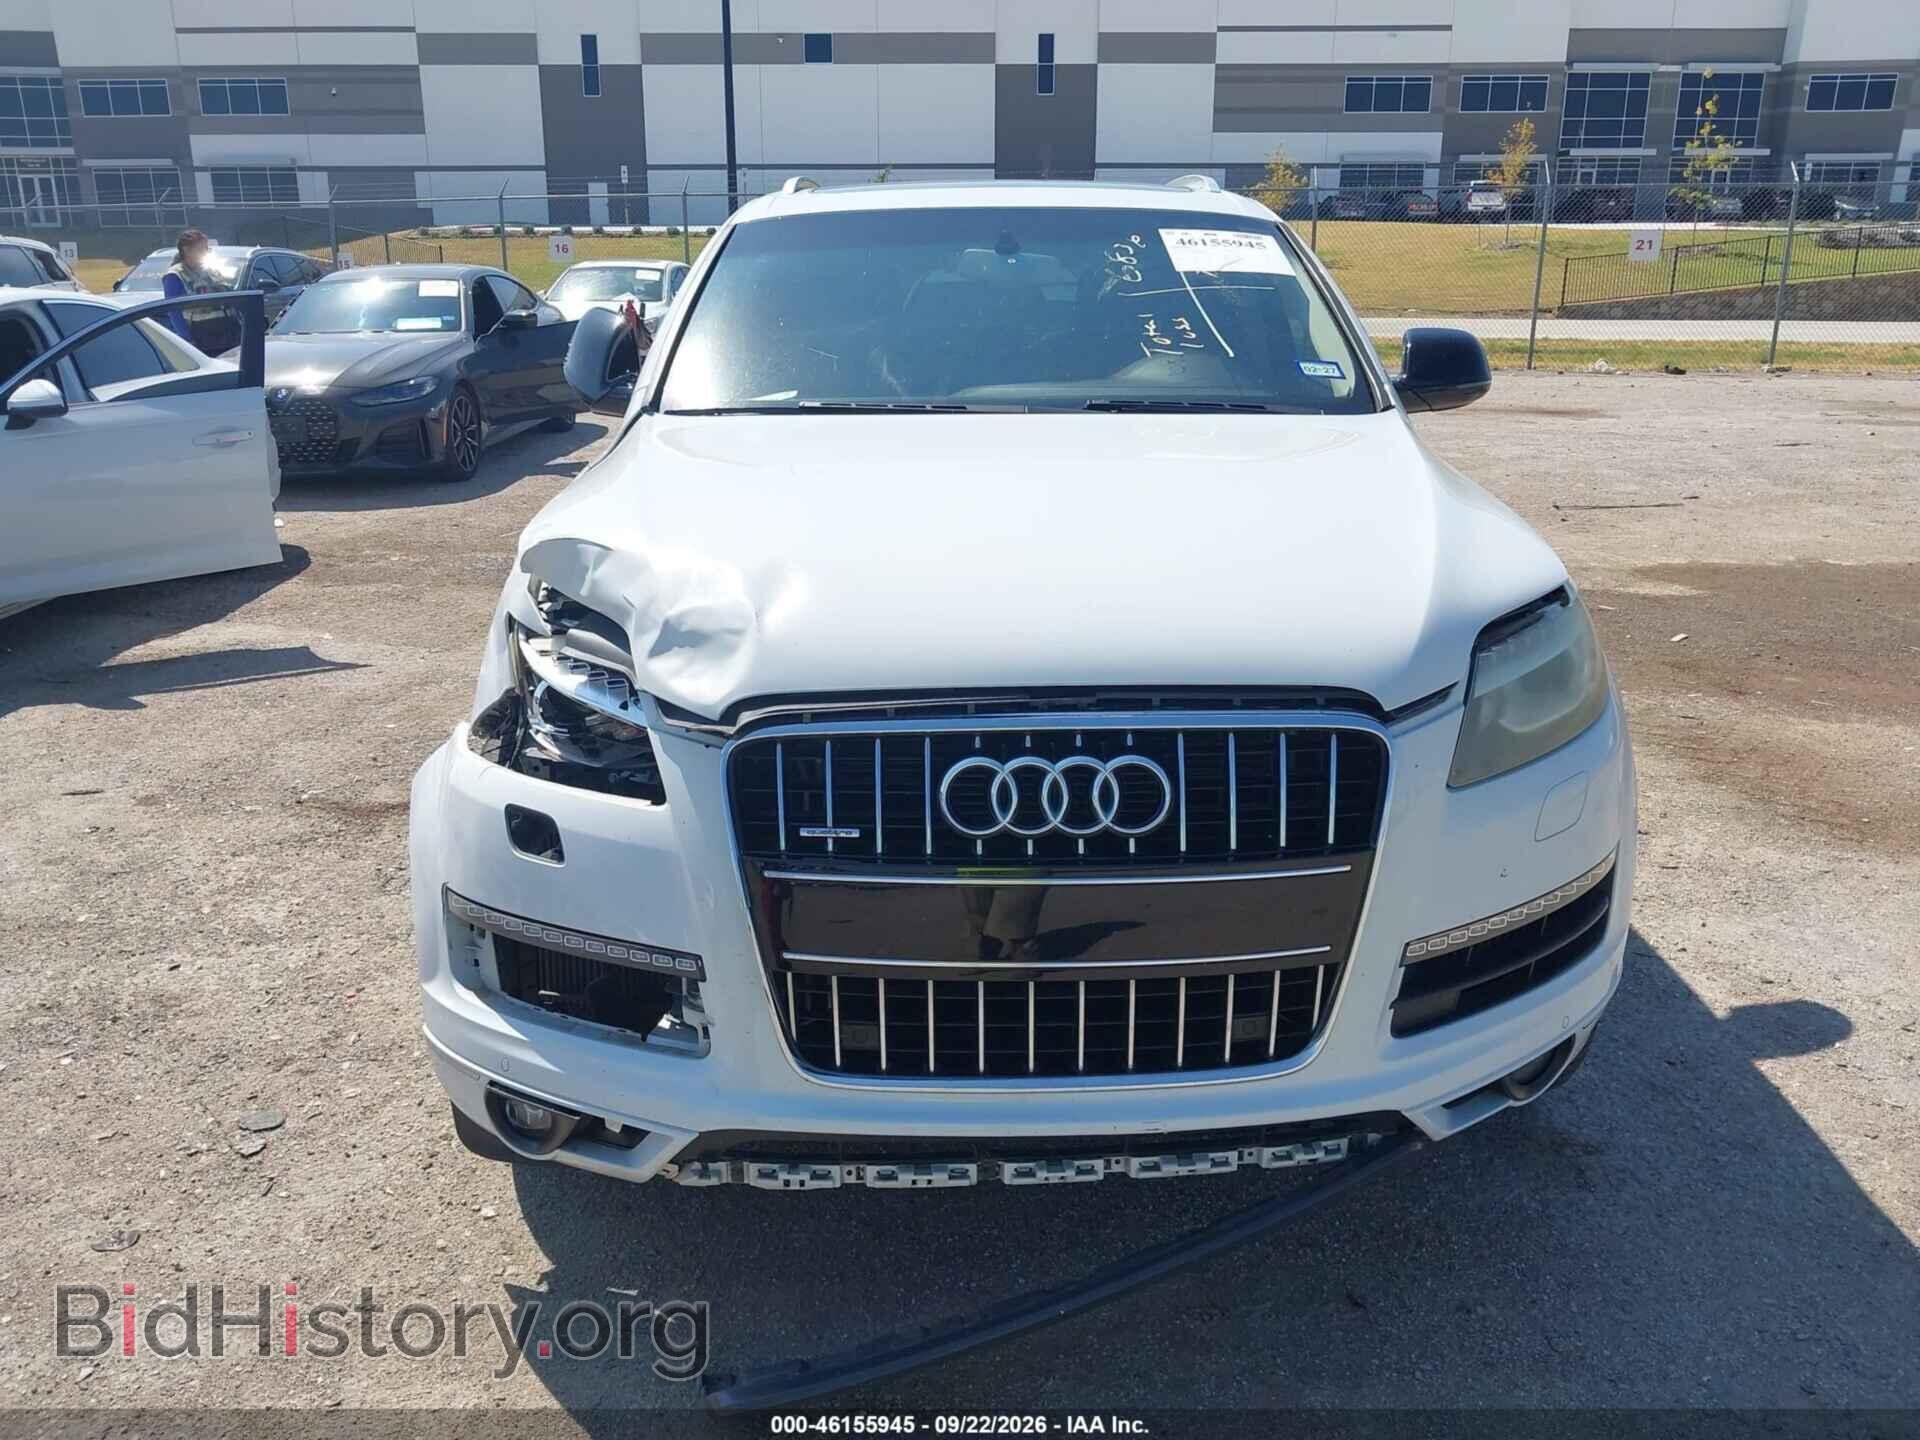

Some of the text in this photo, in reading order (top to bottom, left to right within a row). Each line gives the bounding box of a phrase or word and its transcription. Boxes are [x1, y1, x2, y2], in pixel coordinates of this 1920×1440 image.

[554, 243, 569, 254] 16
[1175, 237, 1267, 250] 46155945
[1635, 239, 1654, 250] 21
[338, 259, 351, 270] 15
